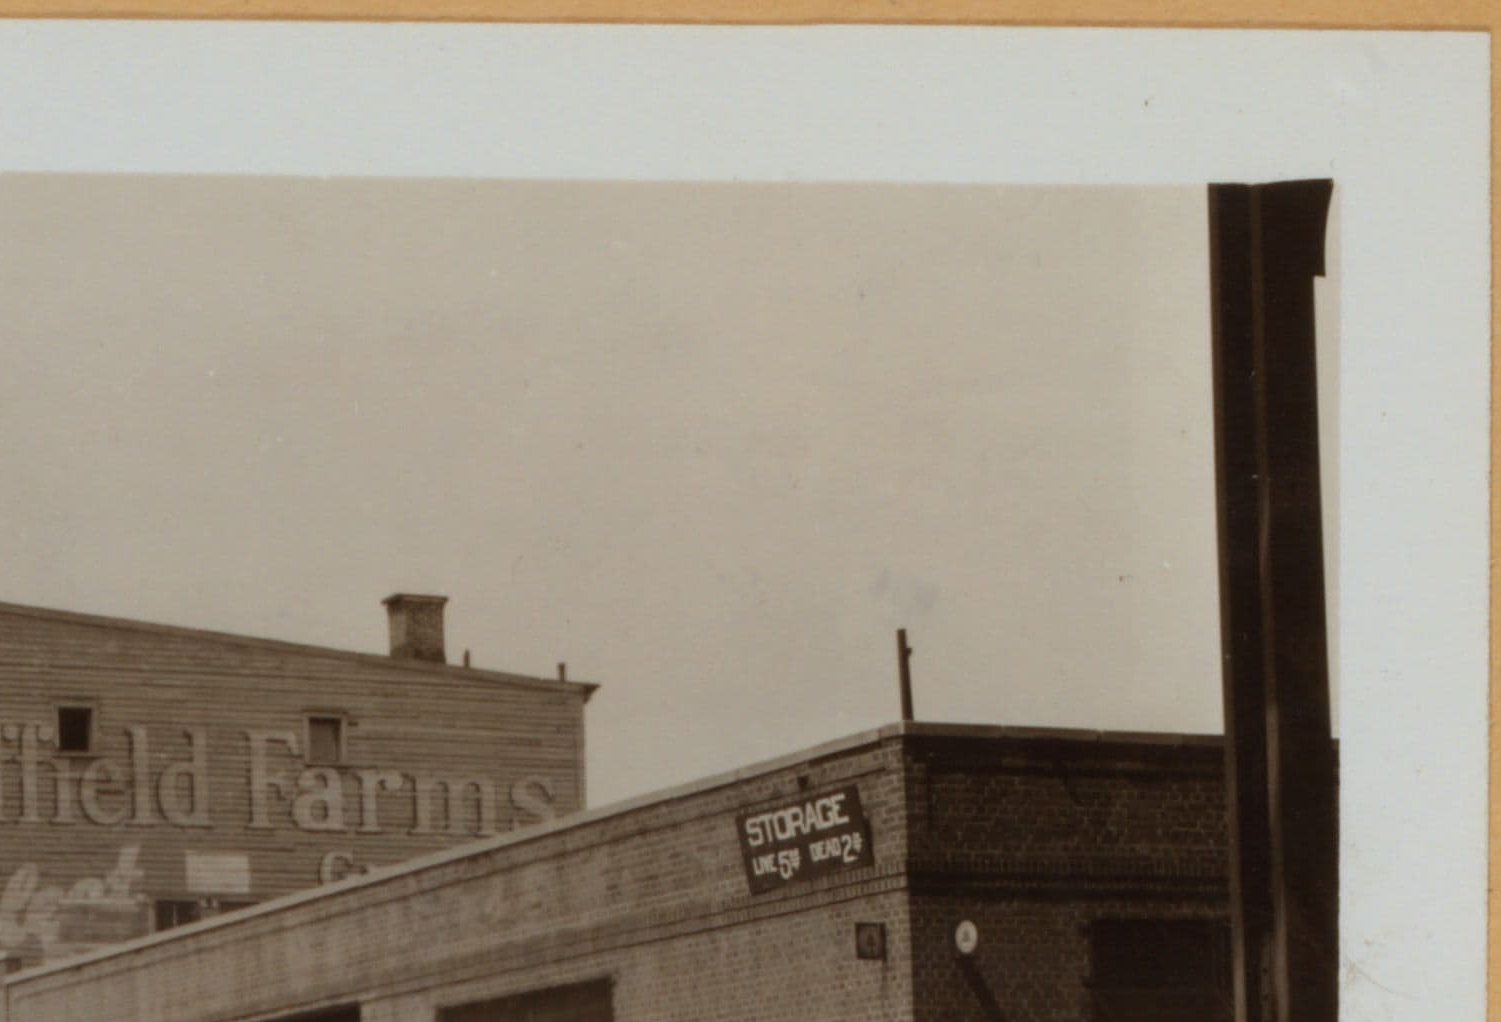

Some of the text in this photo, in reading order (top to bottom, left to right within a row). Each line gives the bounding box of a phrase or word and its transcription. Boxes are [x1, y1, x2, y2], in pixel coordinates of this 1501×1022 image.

[242, 728, 557, 836] Farms
[745, 793, 850, 847] STORAGE
[809, 837, 841, 863] DEAD
